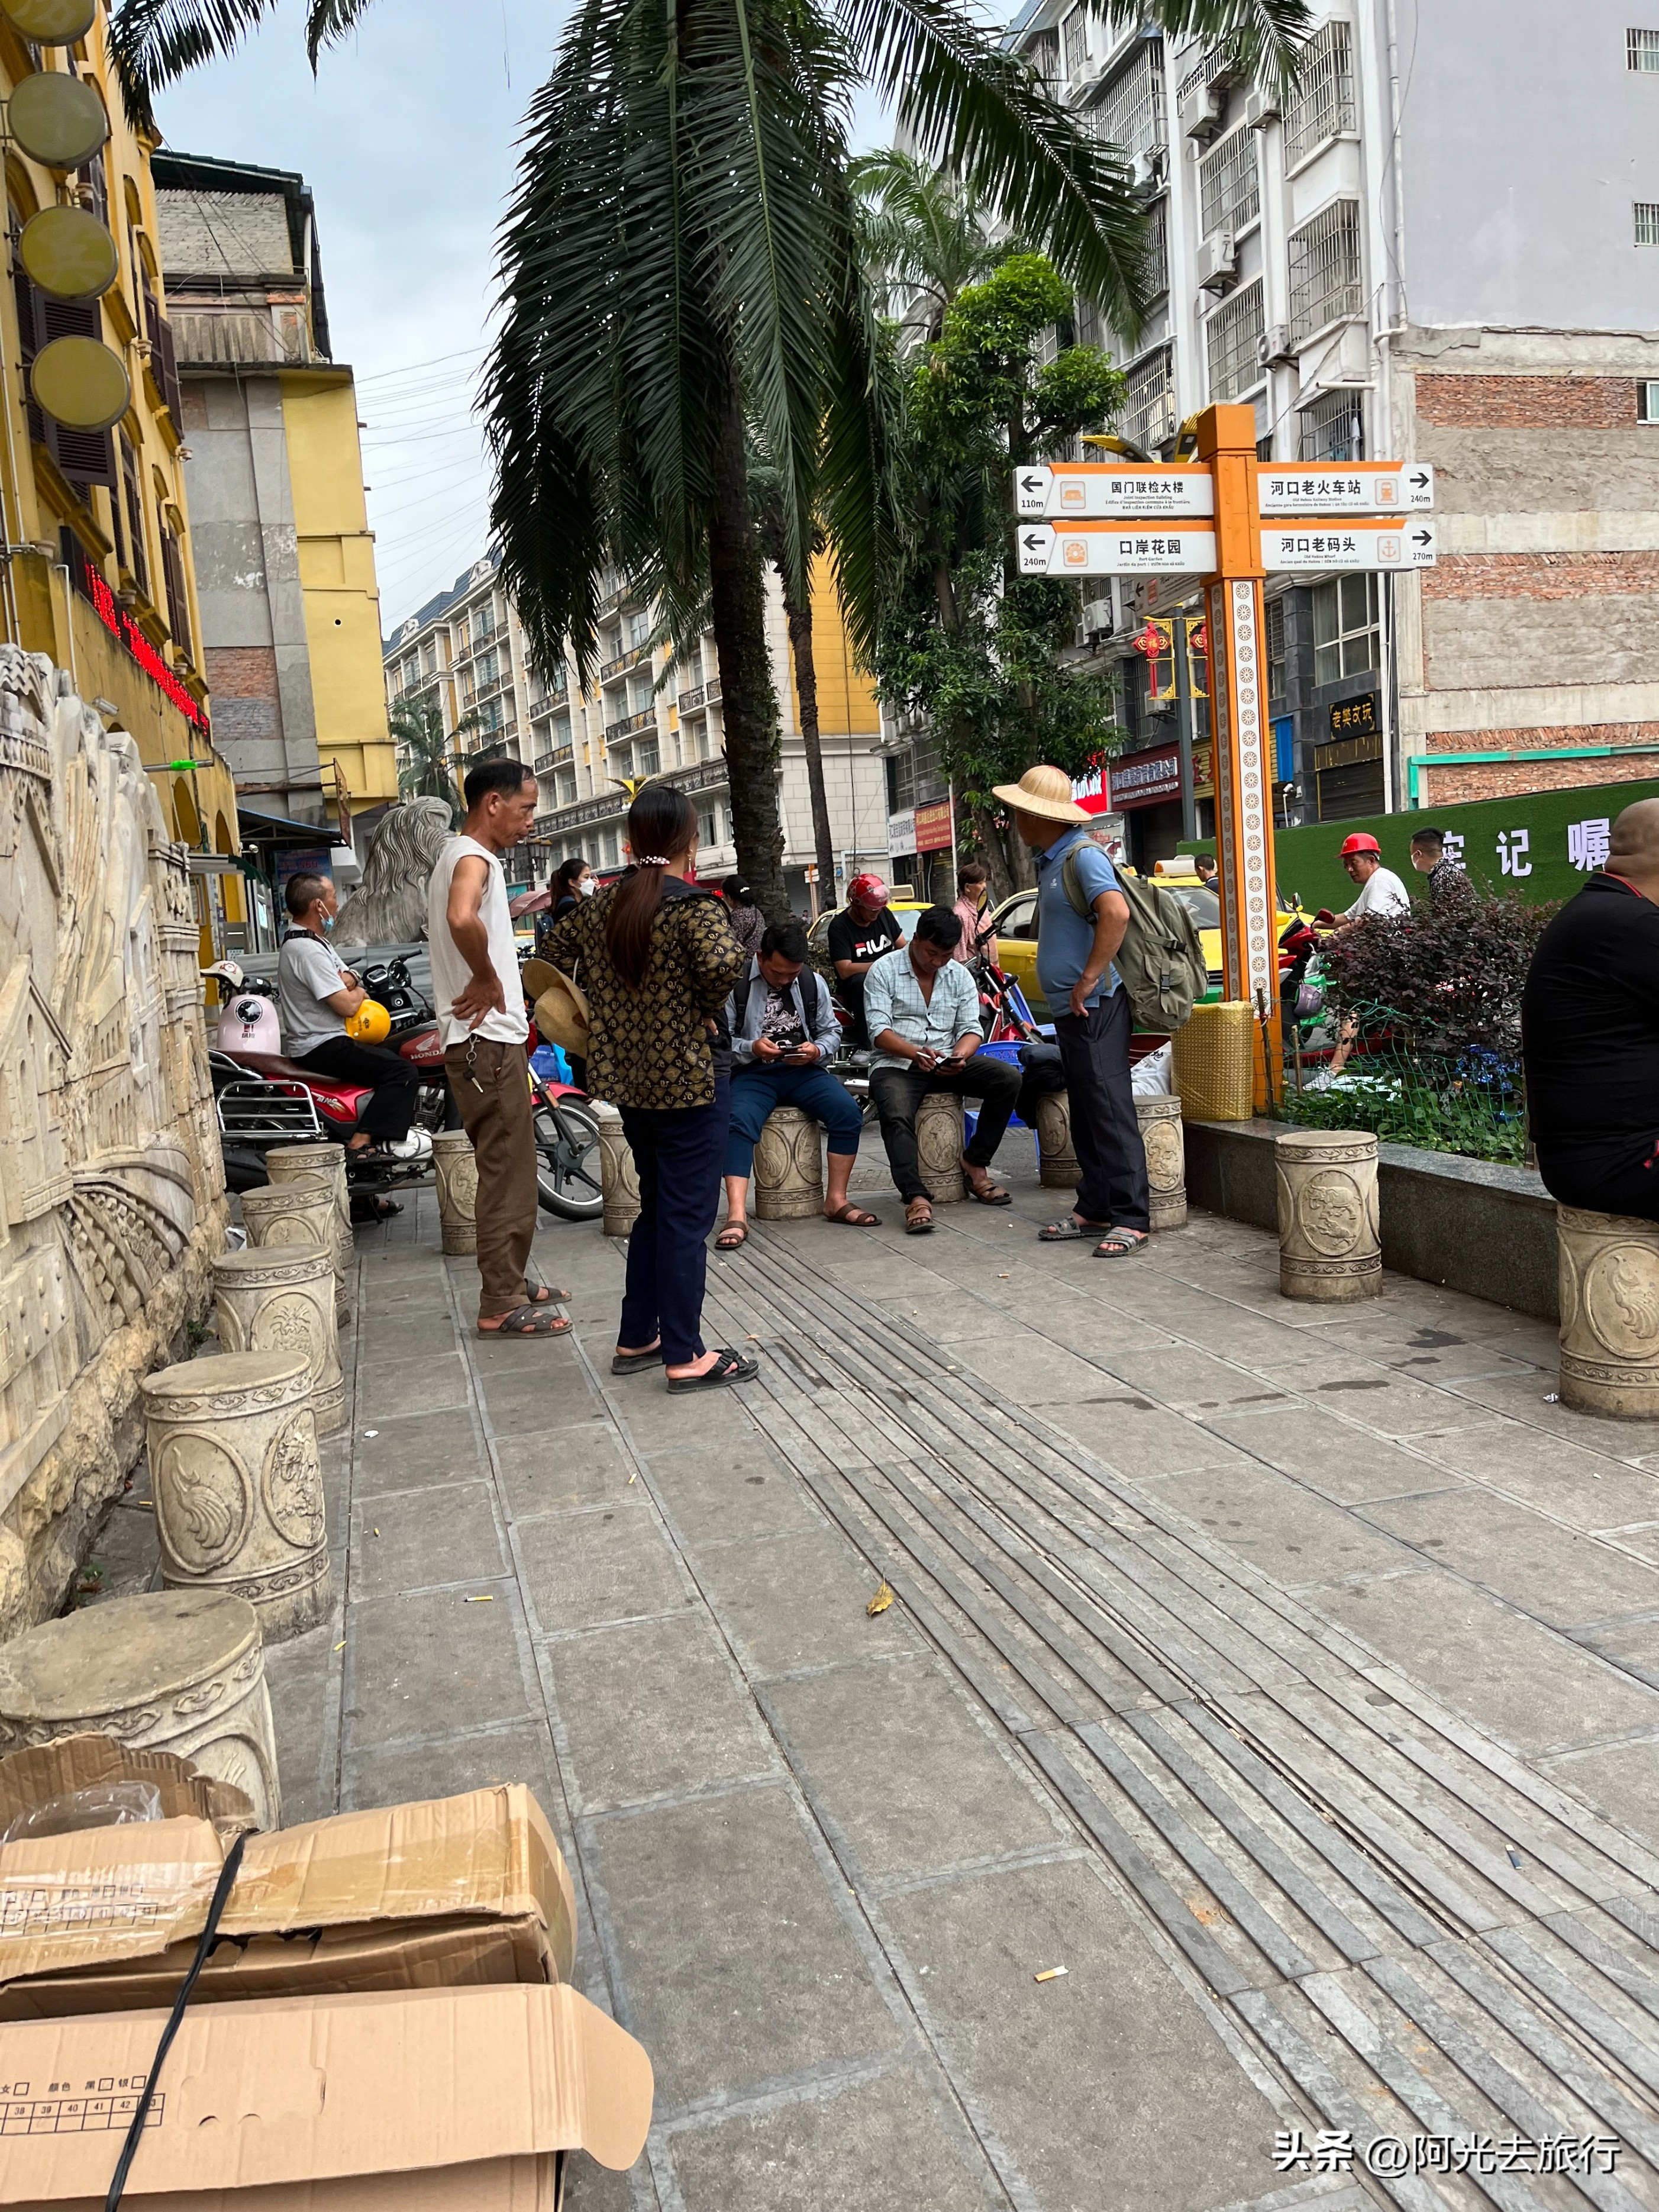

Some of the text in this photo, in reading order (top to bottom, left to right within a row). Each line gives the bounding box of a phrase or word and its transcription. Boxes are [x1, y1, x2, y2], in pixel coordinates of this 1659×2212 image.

[1111, 481, 1184, 494] 国门联检大楼
[1270, 480, 1361, 495] 河口老火车站
[1021, 499, 1044, 508] 110m
[1119, 539, 1181, 554] 口岸花园
[1281, 537, 1355, 553] 河口老码头
[1148, 638, 1157, 648] 福
[855, 934, 892, 957] FILA
[410, 1050, 445, 1060] HOND
[41, 2105, 51, 2114] 39
[67, 2104, 78, 2112] 40
[93, 2102, 104, 2111] 41
[120, 2101, 130, 2109] 42
